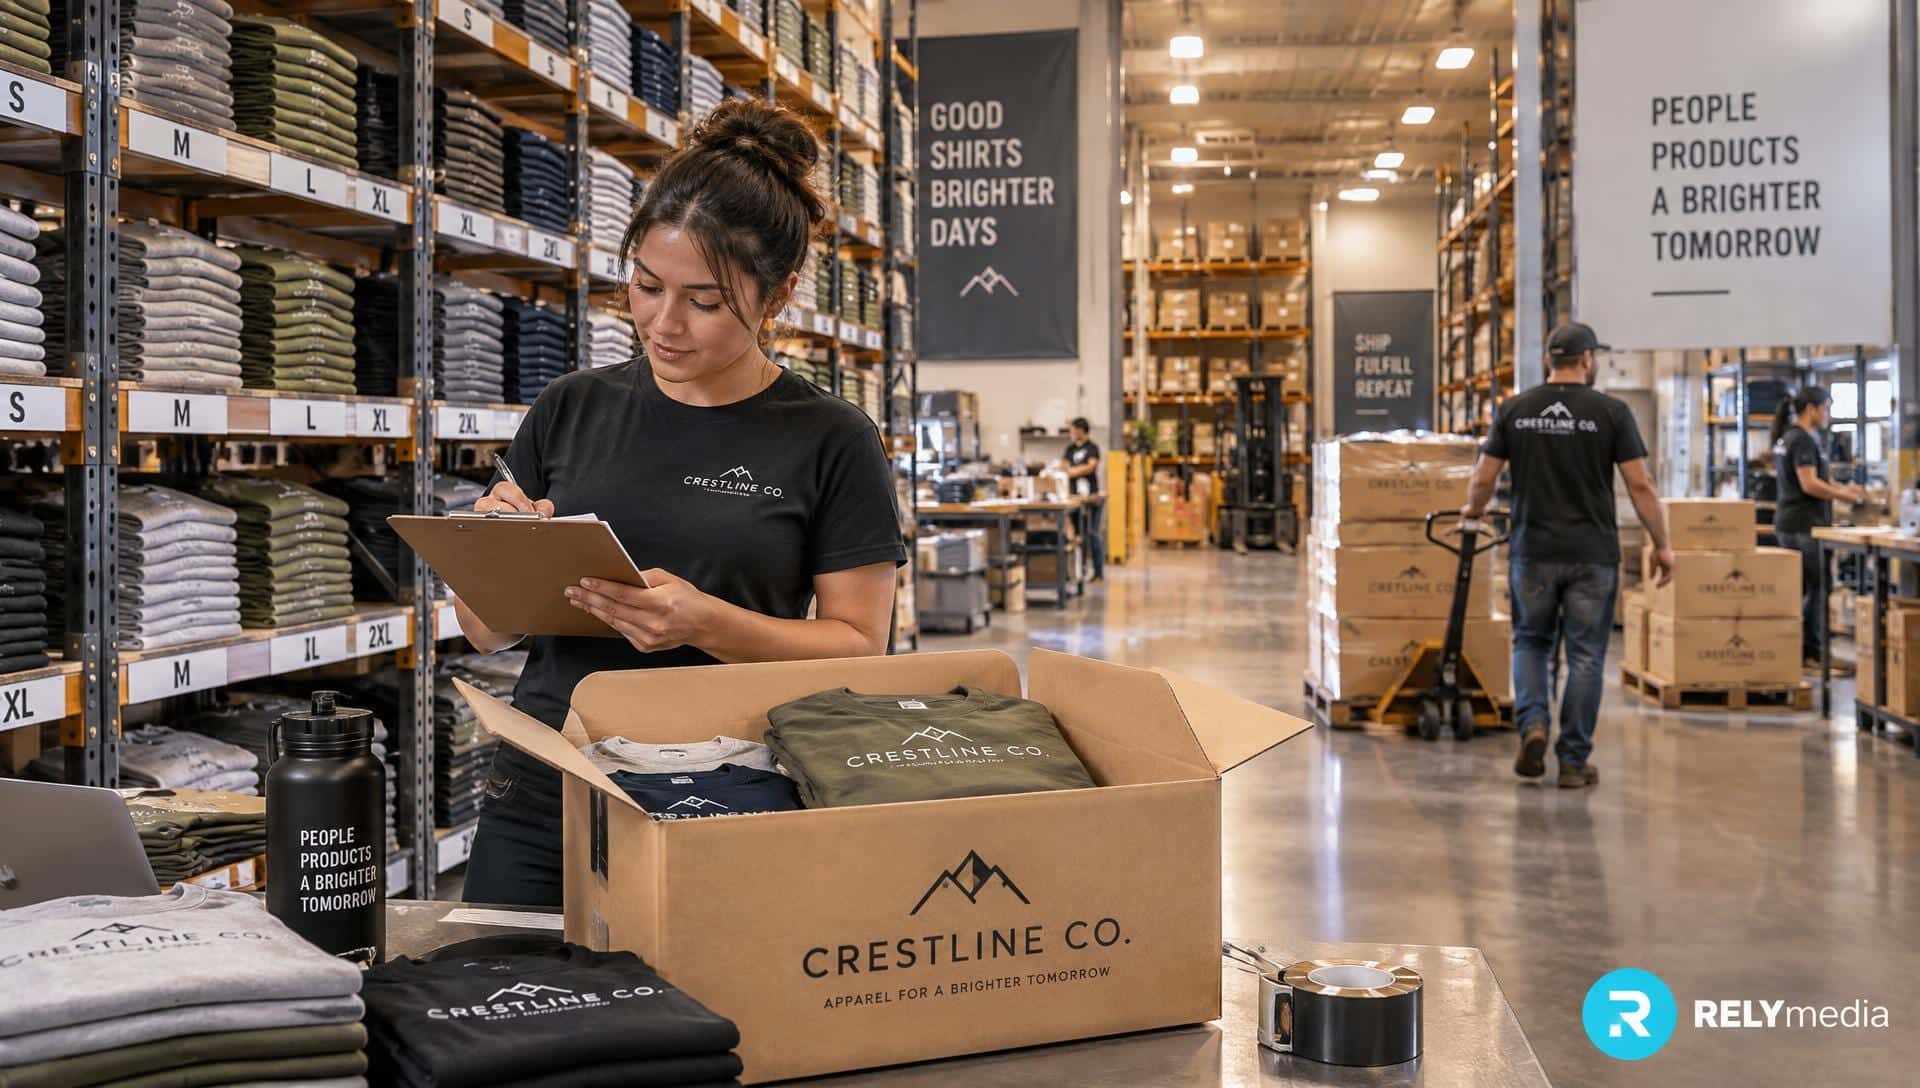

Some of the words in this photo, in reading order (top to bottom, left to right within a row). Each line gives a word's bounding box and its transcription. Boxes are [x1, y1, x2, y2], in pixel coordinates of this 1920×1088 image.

[464, 8, 472, 30] S
[9, 82, 25, 113] S
[1652, 92, 1757, 126] PEOPLE
[931, 101, 1003, 131] GOOD
[174, 129, 190, 159] M
[930, 138, 1023, 170] SHIRTS
[1652, 136, 1799, 171] PRODUCTS
[306, 168, 316, 194] L
[931, 176, 1055, 208] BRIGHTER
[372, 187, 391, 215] XL
[1651, 186, 1669, 216] A
[1682, 180, 1821, 214] BRIGHTER
[461, 213, 477, 237] XL
[931, 216, 998, 247] DAYS
[543, 238, 561, 261] 2XL
[1651, 226, 1821, 261] TOMORROW
[1355, 379, 1414, 398] REPEAT
[9, 391, 25, 423] S
[174, 400, 190, 427] M
[306, 406, 316, 430] L
[372, 408, 391, 432] XL
[459, 414, 480, 434] 2XL
[1515, 418, 1575, 430] CRESTLINE
[683, 476, 759, 492] CRESTLINE
[764, 486, 784, 499] CO.
[368, 624, 393, 649] 2XL
[174, 660, 191, 688] M
[4, 687, 34, 720] XL
[847, 746, 997, 768] CRESTLINE
[1007, 746, 1050, 757] CO.
[300, 826, 355, 846] PEOPLE
[300, 845, 372, 869] PRODUCTS
[300, 875, 310, 891] A
[315, 865, 377, 891] BRIGHTER
[300, 887, 376, 913] TOMORROW
[0, 932, 200, 969] CRESTLINE
[802, 925, 1044, 979] CRESTLINE
[1064, 917, 1131, 950] CO.
[823, 991, 893, 1009] APPAREL
[899, 986, 929, 1001] FOR
[934, 984, 945, 997] A
[950, 976, 1022, 995] BRIGHTER
[1027, 966, 1111, 985] TOMORROW
[427, 992, 601, 1020] CRESTLINE
[612, 986, 664, 1000] CO.
